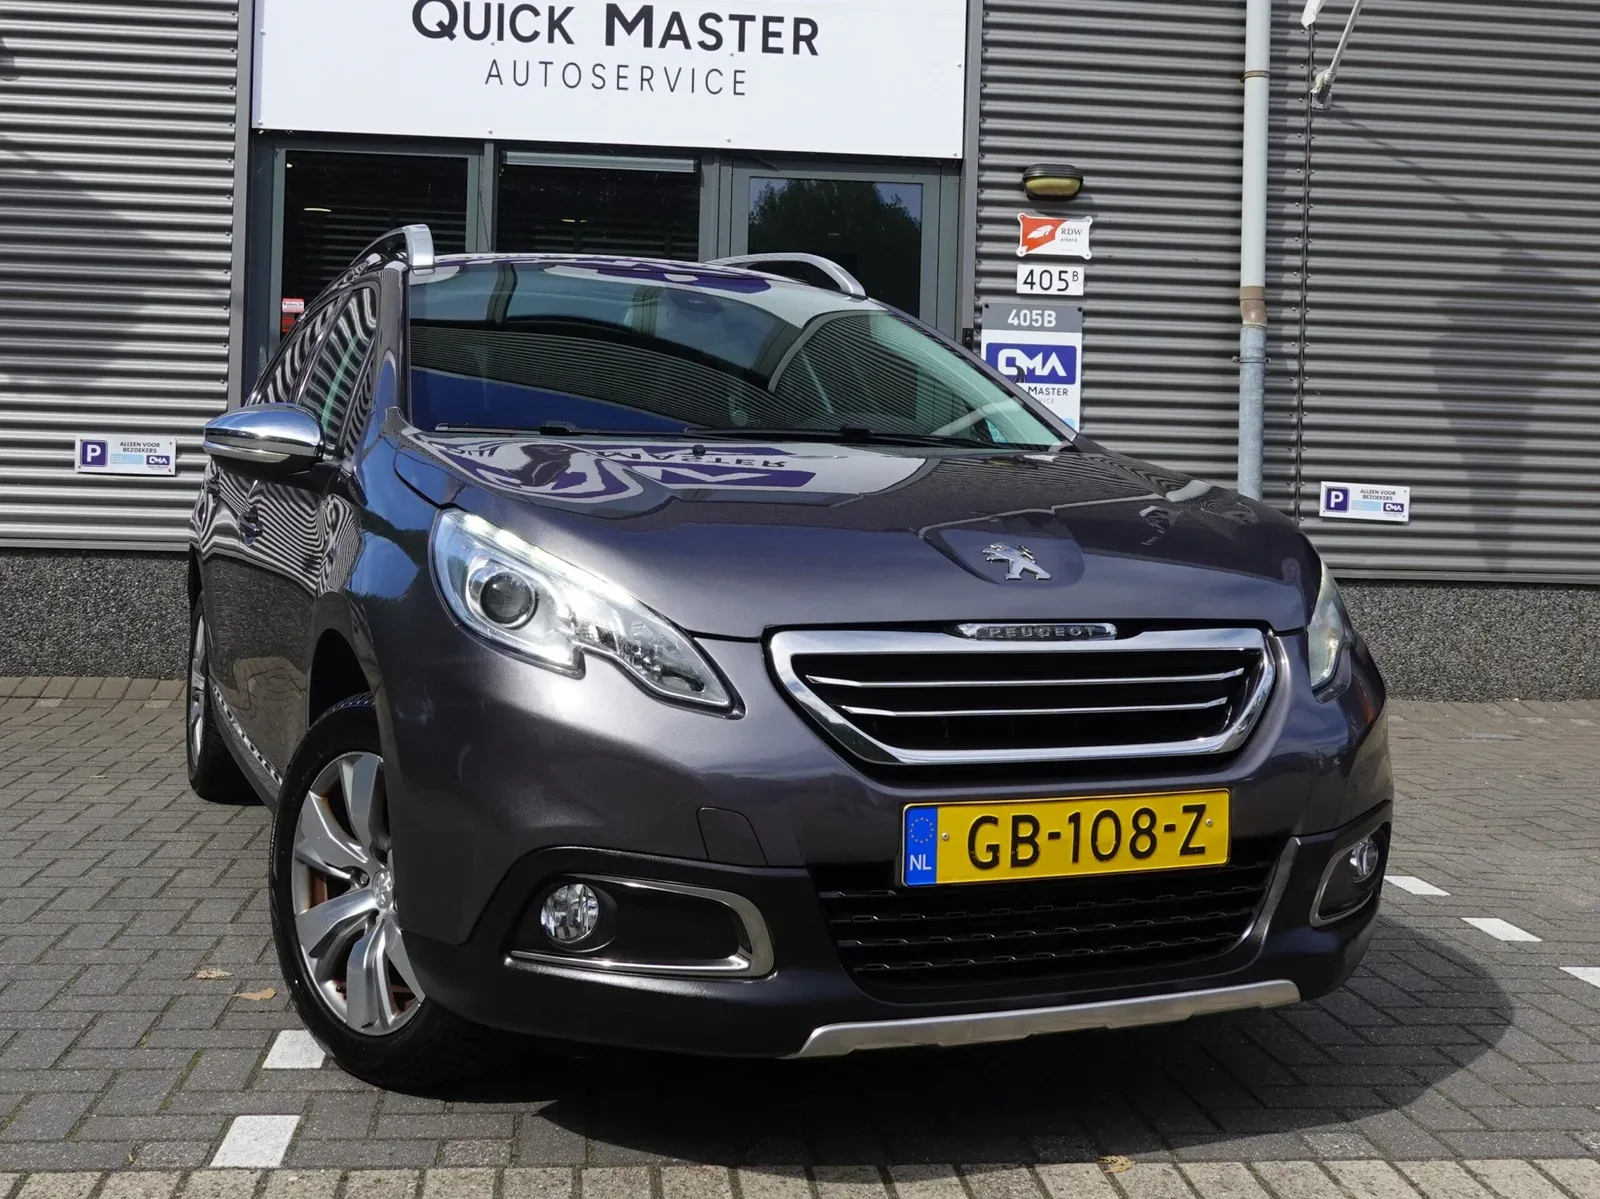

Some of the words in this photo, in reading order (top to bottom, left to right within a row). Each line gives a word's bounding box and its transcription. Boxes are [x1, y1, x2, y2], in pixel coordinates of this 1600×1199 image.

[412, 0, 575, 44] QUICK
[604, 3, 819, 56] MASTER
[485, 59, 746, 96] AUTOSERVICE
[1060, 227, 1083, 236] RDW
[1007, 309, 1057, 328] 405B
[1027, 386, 1069, 396] MASTER
[86, 444, 102, 463] P
[1330, 490, 1344, 508] P
[989, 626, 1096, 638] PEUGEOT
[967, 803, 1207, 870] GB-108-Z
[909, 854, 932, 871] NL
